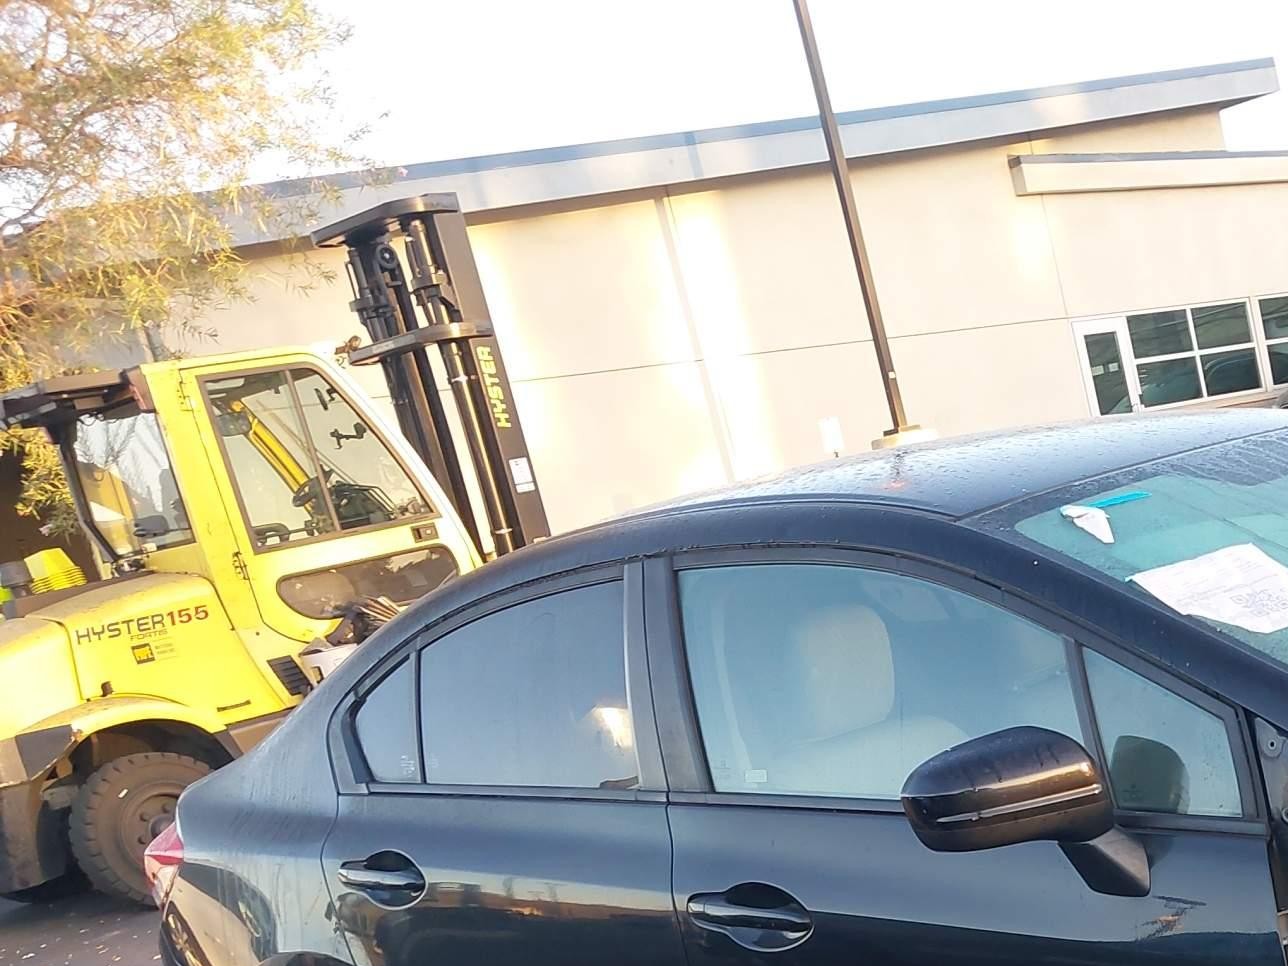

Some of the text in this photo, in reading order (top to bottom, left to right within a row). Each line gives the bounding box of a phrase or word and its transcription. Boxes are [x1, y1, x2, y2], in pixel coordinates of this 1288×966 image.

[476, 346, 512, 428] HYSTER
[75, 604, 209, 645] HYSTER 155
